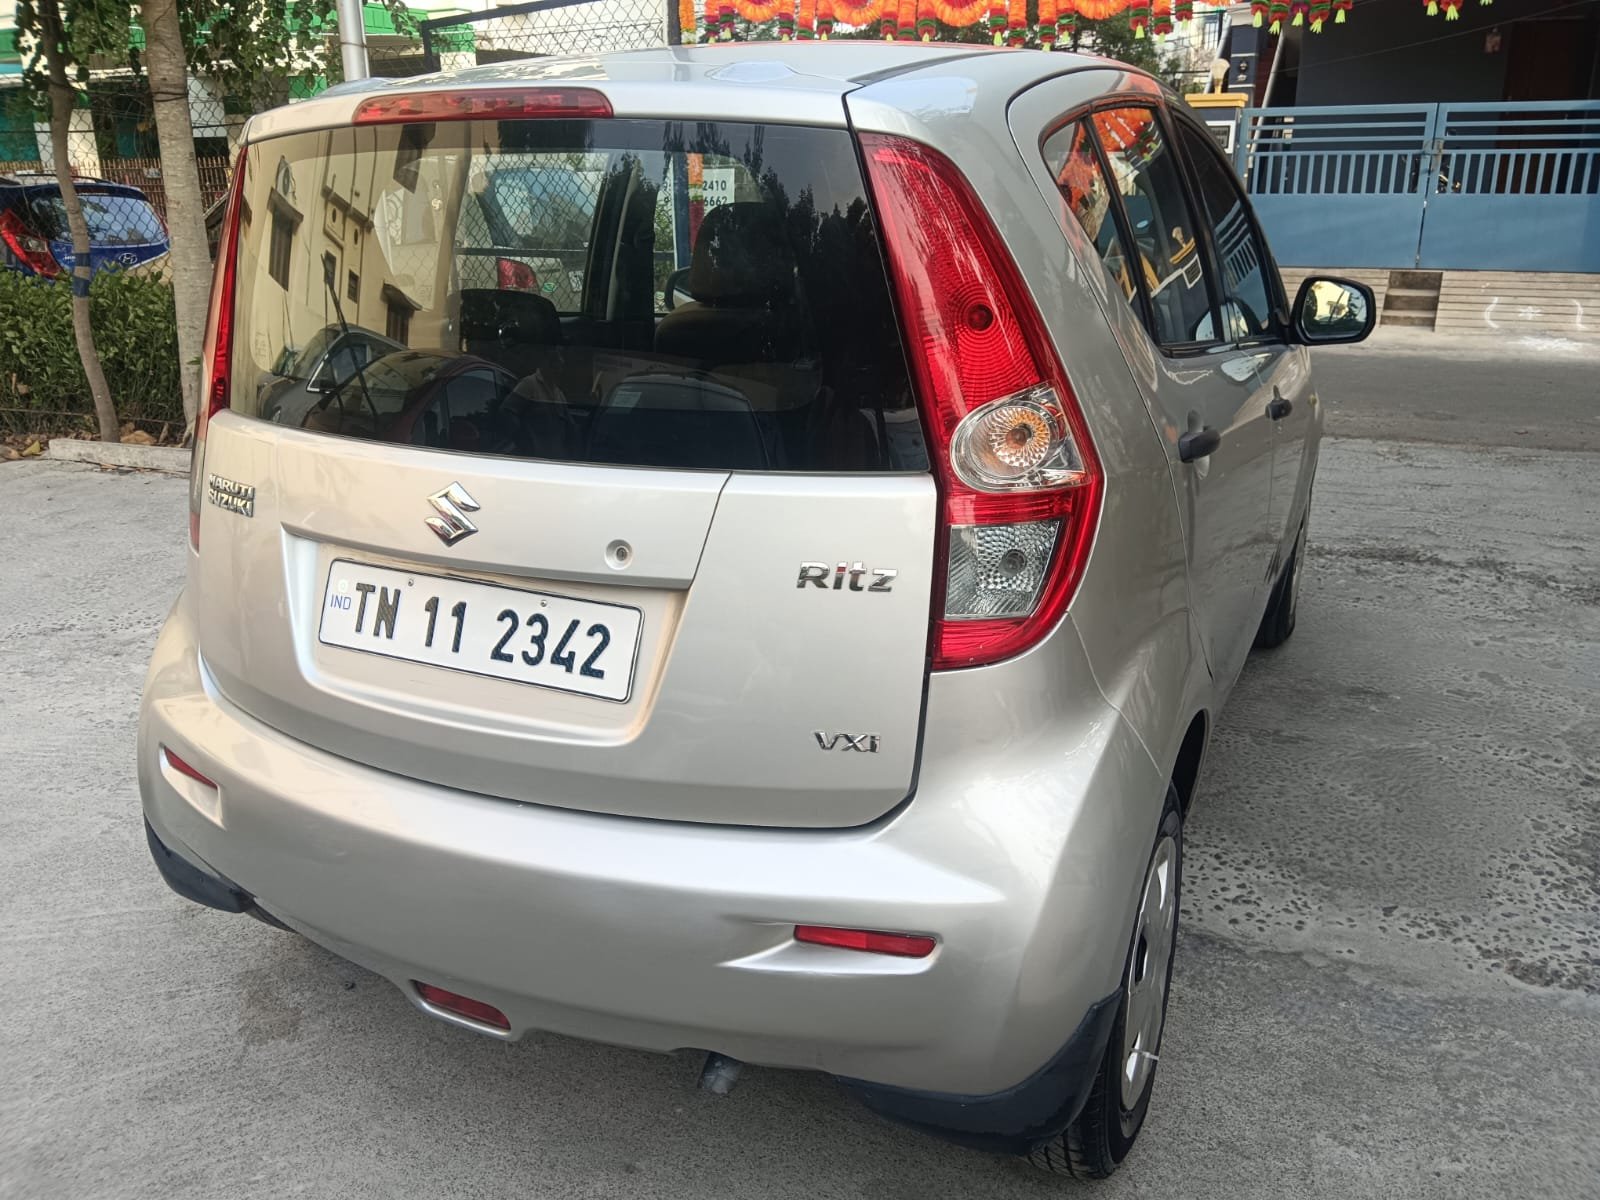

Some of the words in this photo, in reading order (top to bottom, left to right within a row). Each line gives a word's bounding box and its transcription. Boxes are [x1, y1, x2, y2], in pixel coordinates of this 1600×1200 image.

[209, 473, 255, 500] MARUTI
[208, 488, 254, 518] SUZUKI
[796, 561, 898, 593] Ritz
[330, 594, 352, 610] IND
[355, 582, 401, 640] TN
[424, 596, 467, 653] 11
[490, 609, 611, 680] 2342
[813, 730, 881, 754] VXi
